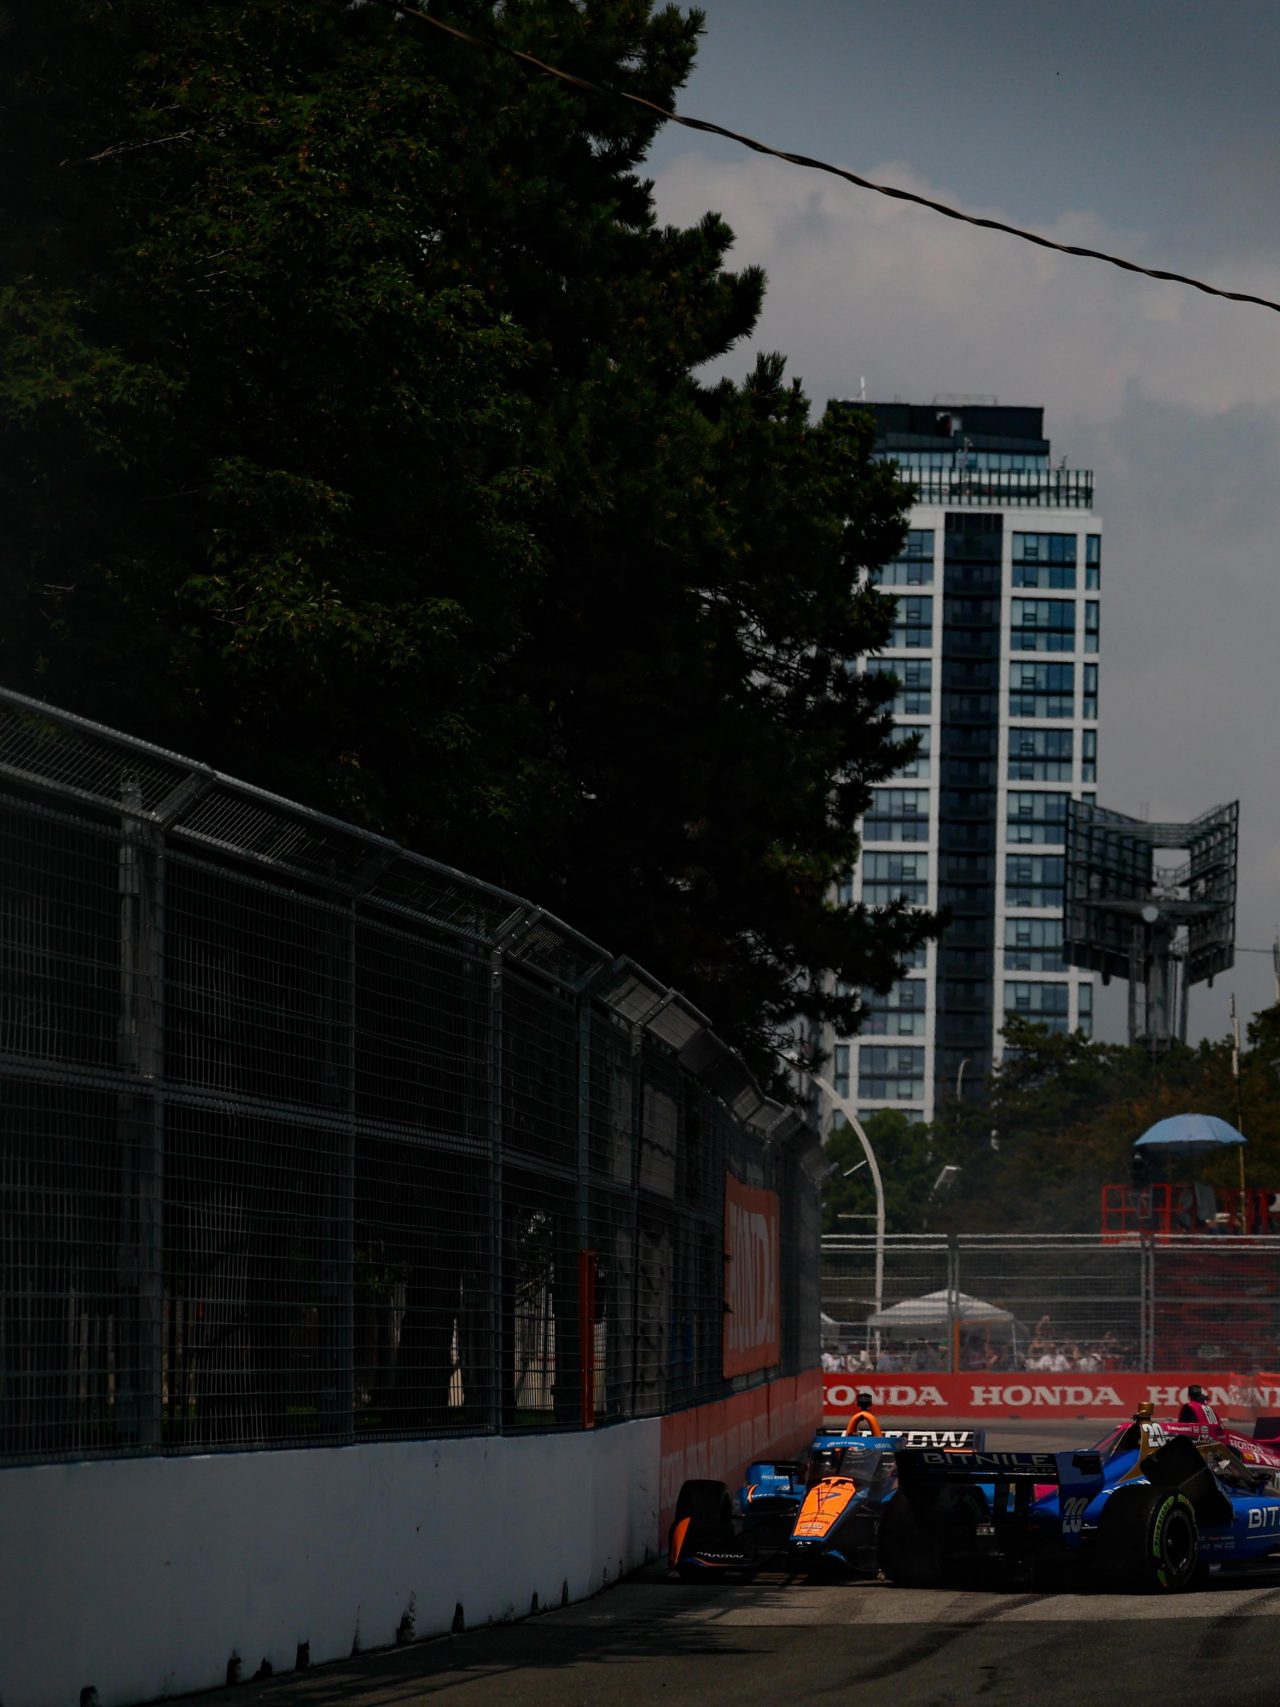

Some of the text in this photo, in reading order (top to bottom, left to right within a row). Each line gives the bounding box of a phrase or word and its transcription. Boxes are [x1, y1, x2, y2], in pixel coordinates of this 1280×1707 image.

[823, 1385, 1125, 1407] ONDA HONDA
[1141, 1423, 1166, 1448] 20
[922, 1452, 1056, 1468] BITNILE
[1062, 1497, 1088, 1534] 20
